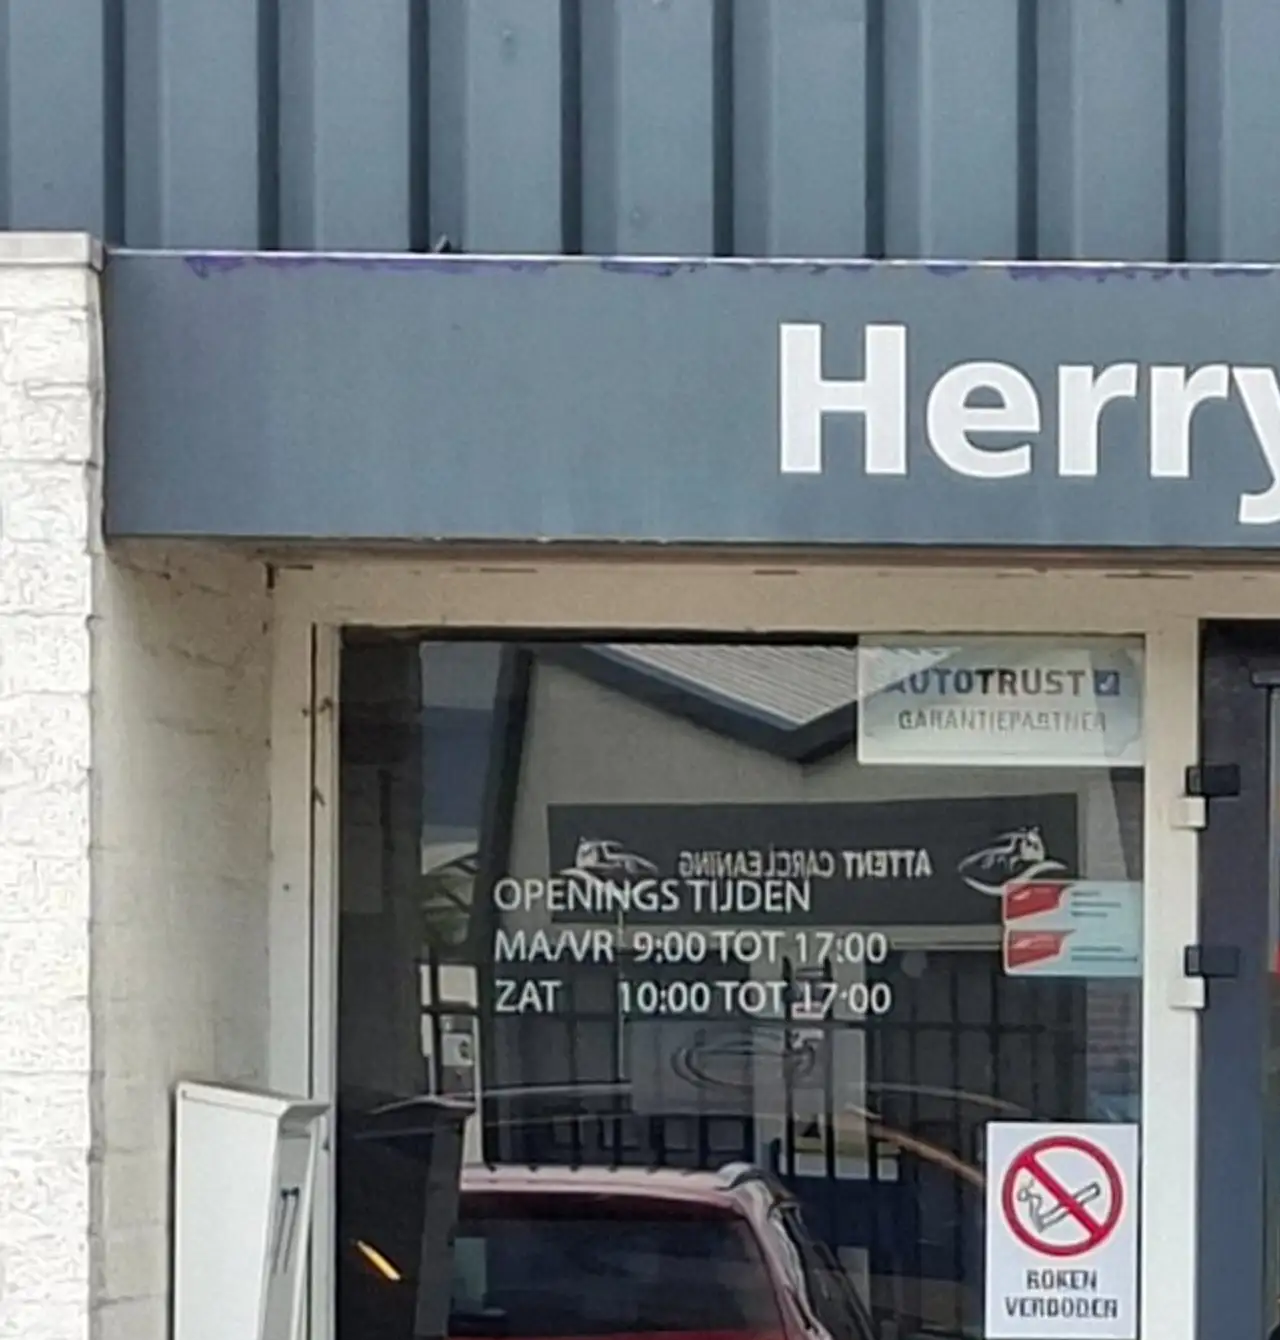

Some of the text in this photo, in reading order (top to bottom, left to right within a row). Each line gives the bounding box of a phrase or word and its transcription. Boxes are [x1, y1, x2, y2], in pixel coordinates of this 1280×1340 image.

[494, 878, 811, 912] OPENINGS TIJDEN
[494, 929, 888, 963] MA/VR 9:00 TOT 17:00
[495, 980, 893, 1014] ZAT 10:00 TOT 17:00
[1026, 1269, 1098, 1291] ROKEN
[1003, 1296, 1119, 1319] VERBODEN
